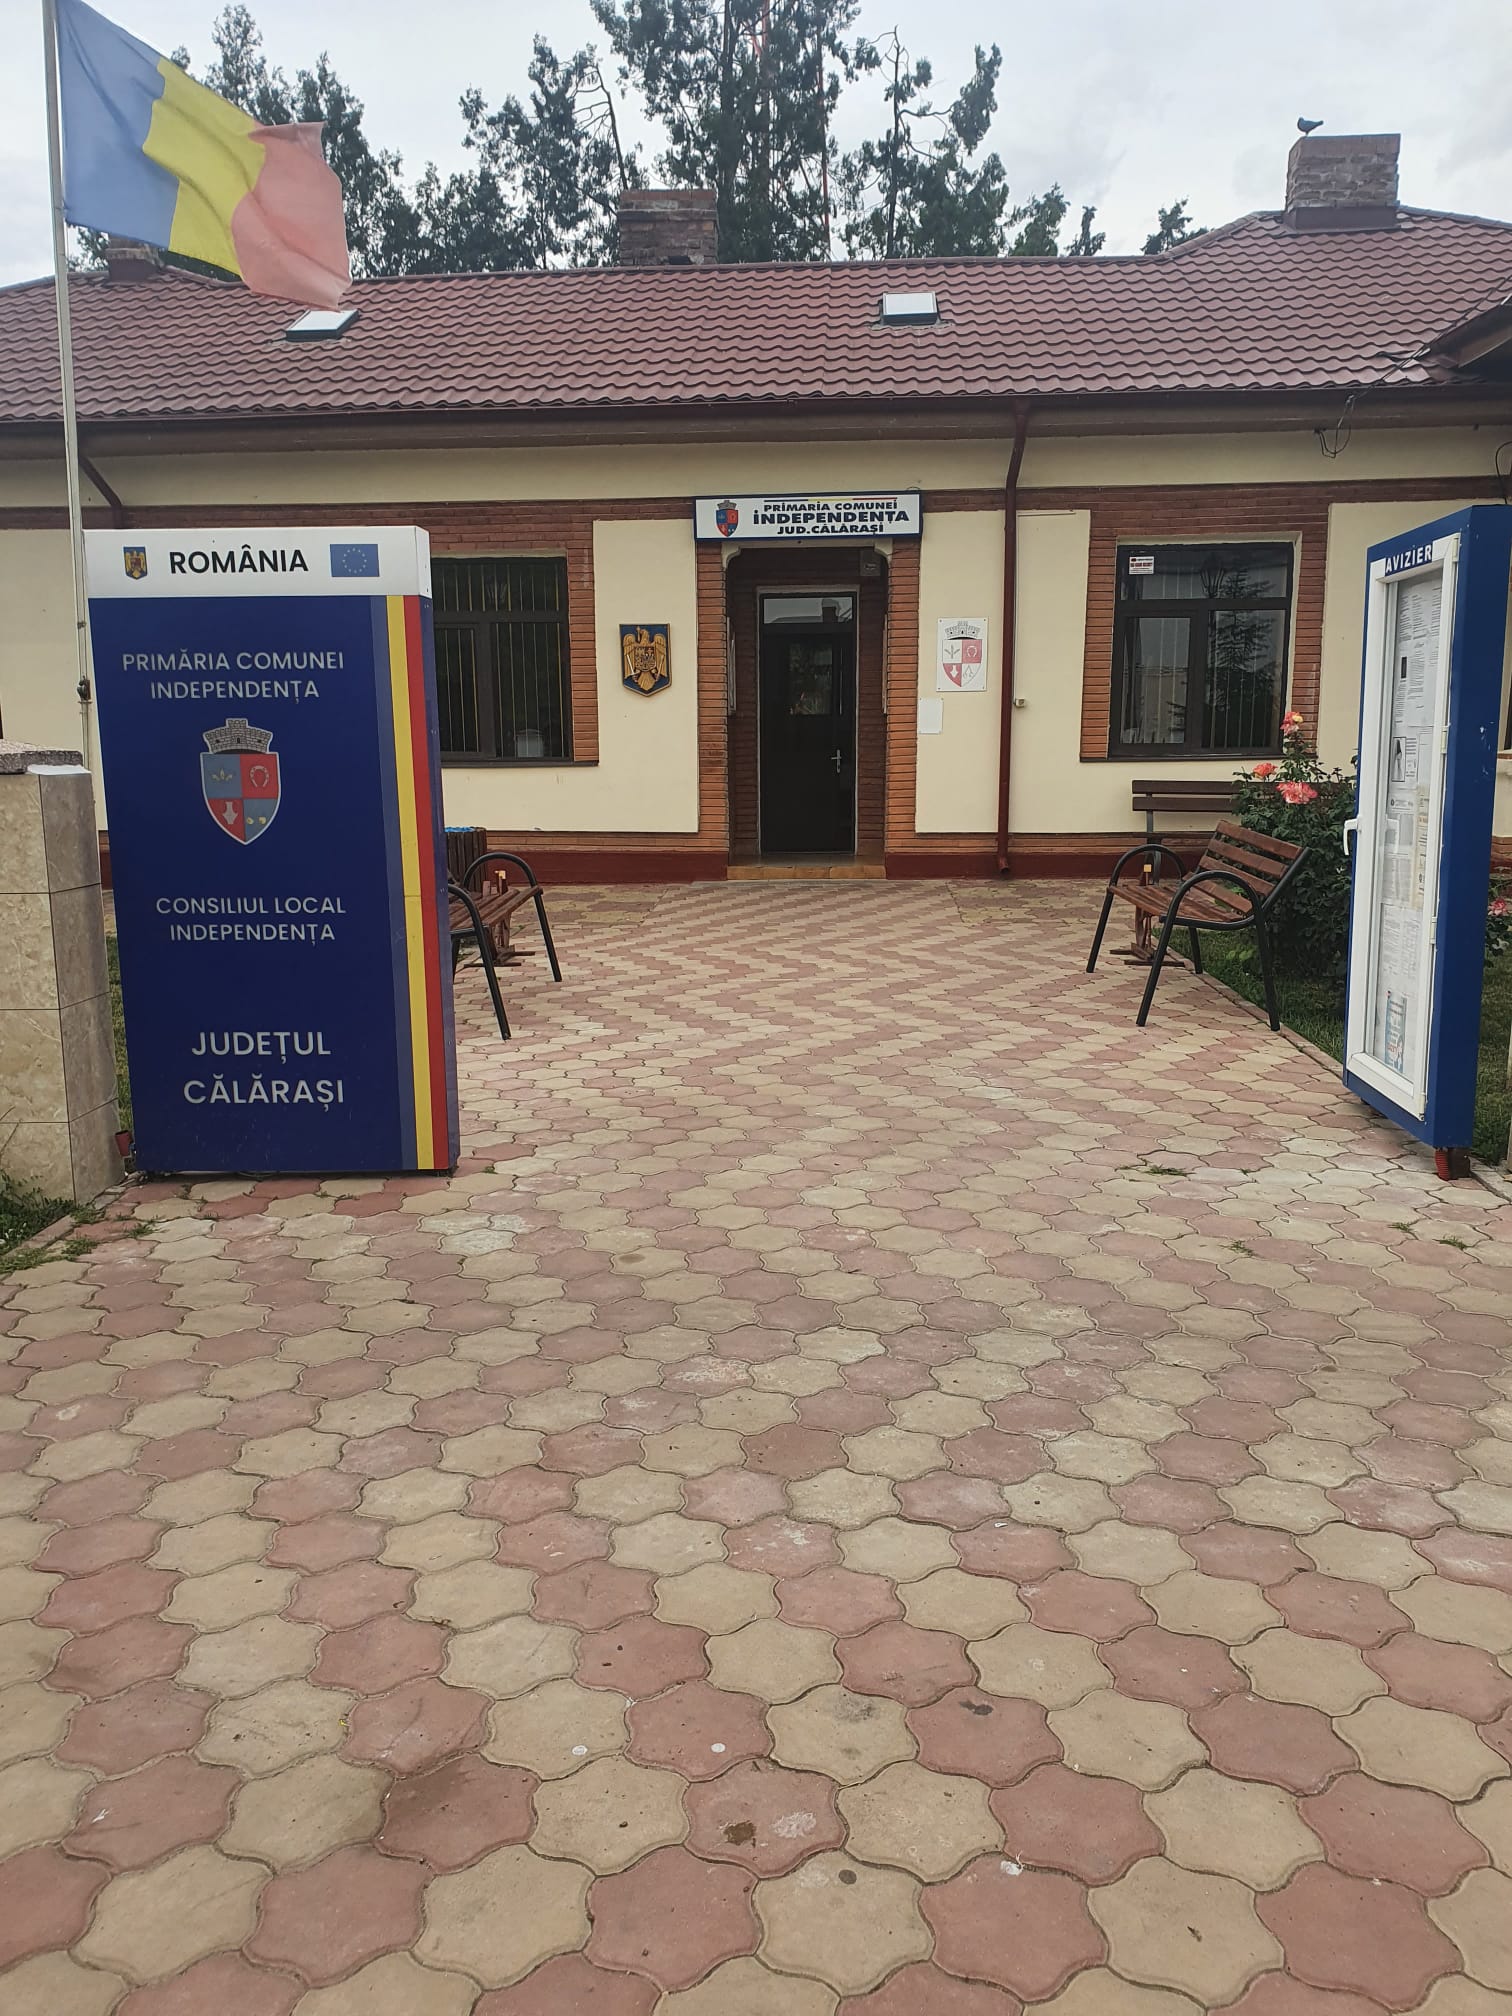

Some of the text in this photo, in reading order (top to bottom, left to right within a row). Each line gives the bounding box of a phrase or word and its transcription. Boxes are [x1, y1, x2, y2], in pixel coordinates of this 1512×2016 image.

[169, 544, 309, 574] ROMÂNIA
[1385, 544, 1432, 574] AVIZIER
[122, 648, 344, 671] PRIMĂRIA COMUNEI
[150, 679, 319, 704] INDEPENDENȚA
[155, 896, 346, 914] CONSILIUL LOCAL
[170, 924, 336, 946] INDEPENDENȚA
[191, 1031, 331, 1064] JUDEȚUL
[183, 1073, 344, 1112] CĂLĂRAȘI
